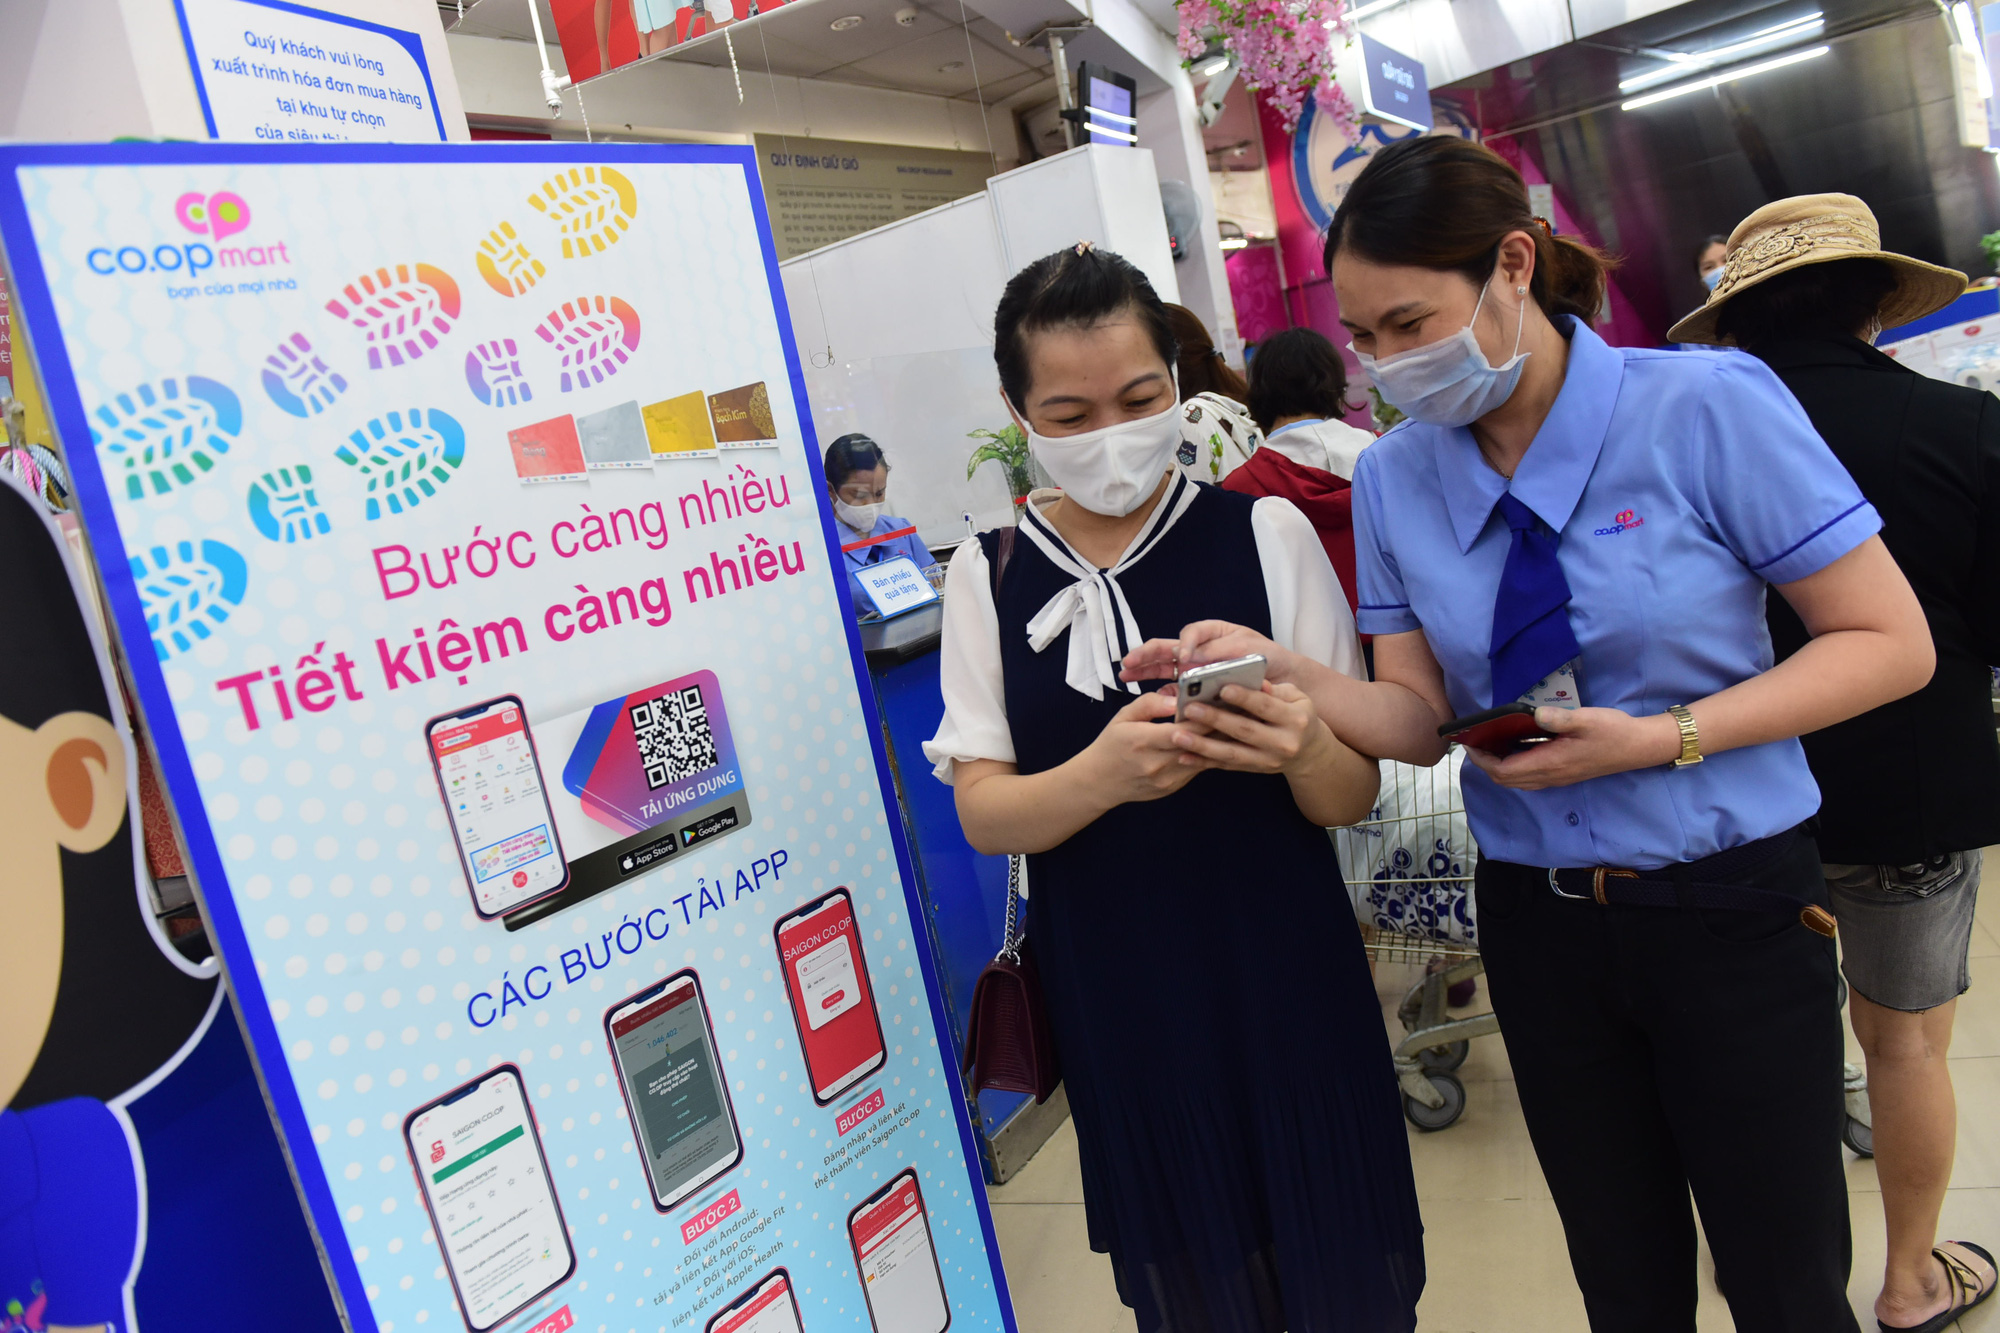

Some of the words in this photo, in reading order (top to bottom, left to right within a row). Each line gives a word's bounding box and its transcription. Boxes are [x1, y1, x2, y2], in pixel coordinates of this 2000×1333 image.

[244, 31, 276, 54] Quý
[280, 38, 326, 61] khách
[329, 50, 350, 66] vui
[353, 53, 384, 76] lòng
[212, 56, 247, 77] xuất
[252, 62, 290, 83] trình
[295, 71, 321, 89] hóa
[325, 76, 354, 95] đơn
[358, 85, 387, 100] mua
[389, 88, 422, 110] hàng
[255, 123, 283, 140] của
[277, 97, 296, 116] tại
[300, 100, 327, 118] khu
[331, 107, 347, 125] tự
[351, 110, 386, 129] chọn
[167, 286, 200, 300] bạn
[204, 281, 234, 295] của
[238, 279, 264, 294] mọi
[268, 277, 297, 291] nhà
[371, 525, 537, 601] Bước
[550, 503, 669, 559] càng
[678, 464, 792, 529] nhiều
[872, 577, 889, 588] Bán
[890, 569, 912, 585] phiếu
[884, 588, 901, 600] quà
[900, 582, 919, 596] tặng
[215, 640, 364, 733] Tiết
[375, 615, 529, 692] kiệm
[543, 583, 673, 642] càng
[683, 532, 806, 604] nhiều
[640, 799, 662, 819] TẢI
[665, 787, 696, 809] ỨNG
[697, 770, 736, 796] DỤNG
[698, 821, 721, 837] Google
[721, 817, 735, 827] Play
[636, 852, 652, 865] App
[653, 844, 673, 858] Store
[467, 971, 552, 1028] CÁC
[560, 908, 670, 984] BƯỚC
[672, 878, 726, 925] TẢI
[734, 849, 789, 901] APP
[784, 934, 821, 961] SAIGON
[822, 916, 852, 939] CO.OP
[451, 1119, 481, 1139] SAIGON
[823, 1147, 846, 1166] Đăng
[846, 1131, 867, 1150] nhập
[868, 1124, 878, 1134] và
[878, 1114, 893, 1128] liên
[893, 1102, 906, 1116] kết
[839, 1102, 873, 1132] BƯỚC
[874, 1096, 882, 1107] 3
[814, 1175, 829, 1189] thẻ
[829, 1157, 854, 1178] thành
[854, 1144, 872, 1160] viên
[872, 1125, 898, 1147] Saigon
[898, 1108, 920, 1127] Co.op
[683, 1249, 702, 1266] Đối
[703, 1236, 718, 1252] với
[719, 1208, 759, 1242] Android:
[685, 1204, 727, 1240] BƯỚC
[728, 1197, 738, 1210] 2
[653, 1292, 667, 1306] tải
[668, 1284, 681, 1296] và
[682, 1268, 701, 1286] liên
[702, 1254, 719, 1272] kết
[719, 1242, 739, 1260] App
[740, 1217, 772, 1243] Google
[773, 1206, 786, 1220] Fit
[703, 1270, 721, 1287] Đối
[722, 1257, 737, 1274] với
[737, 1244, 757, 1262] iOS:
[671, 1310, 691, 1328] liên
[692, 1296, 709, 1314] kết
[709, 1283, 725, 1300] với
[726, 1264, 753, 1289] Apple
[754, 1241, 784, 1267] Health
[560, 1313, 568, 1327] 1
